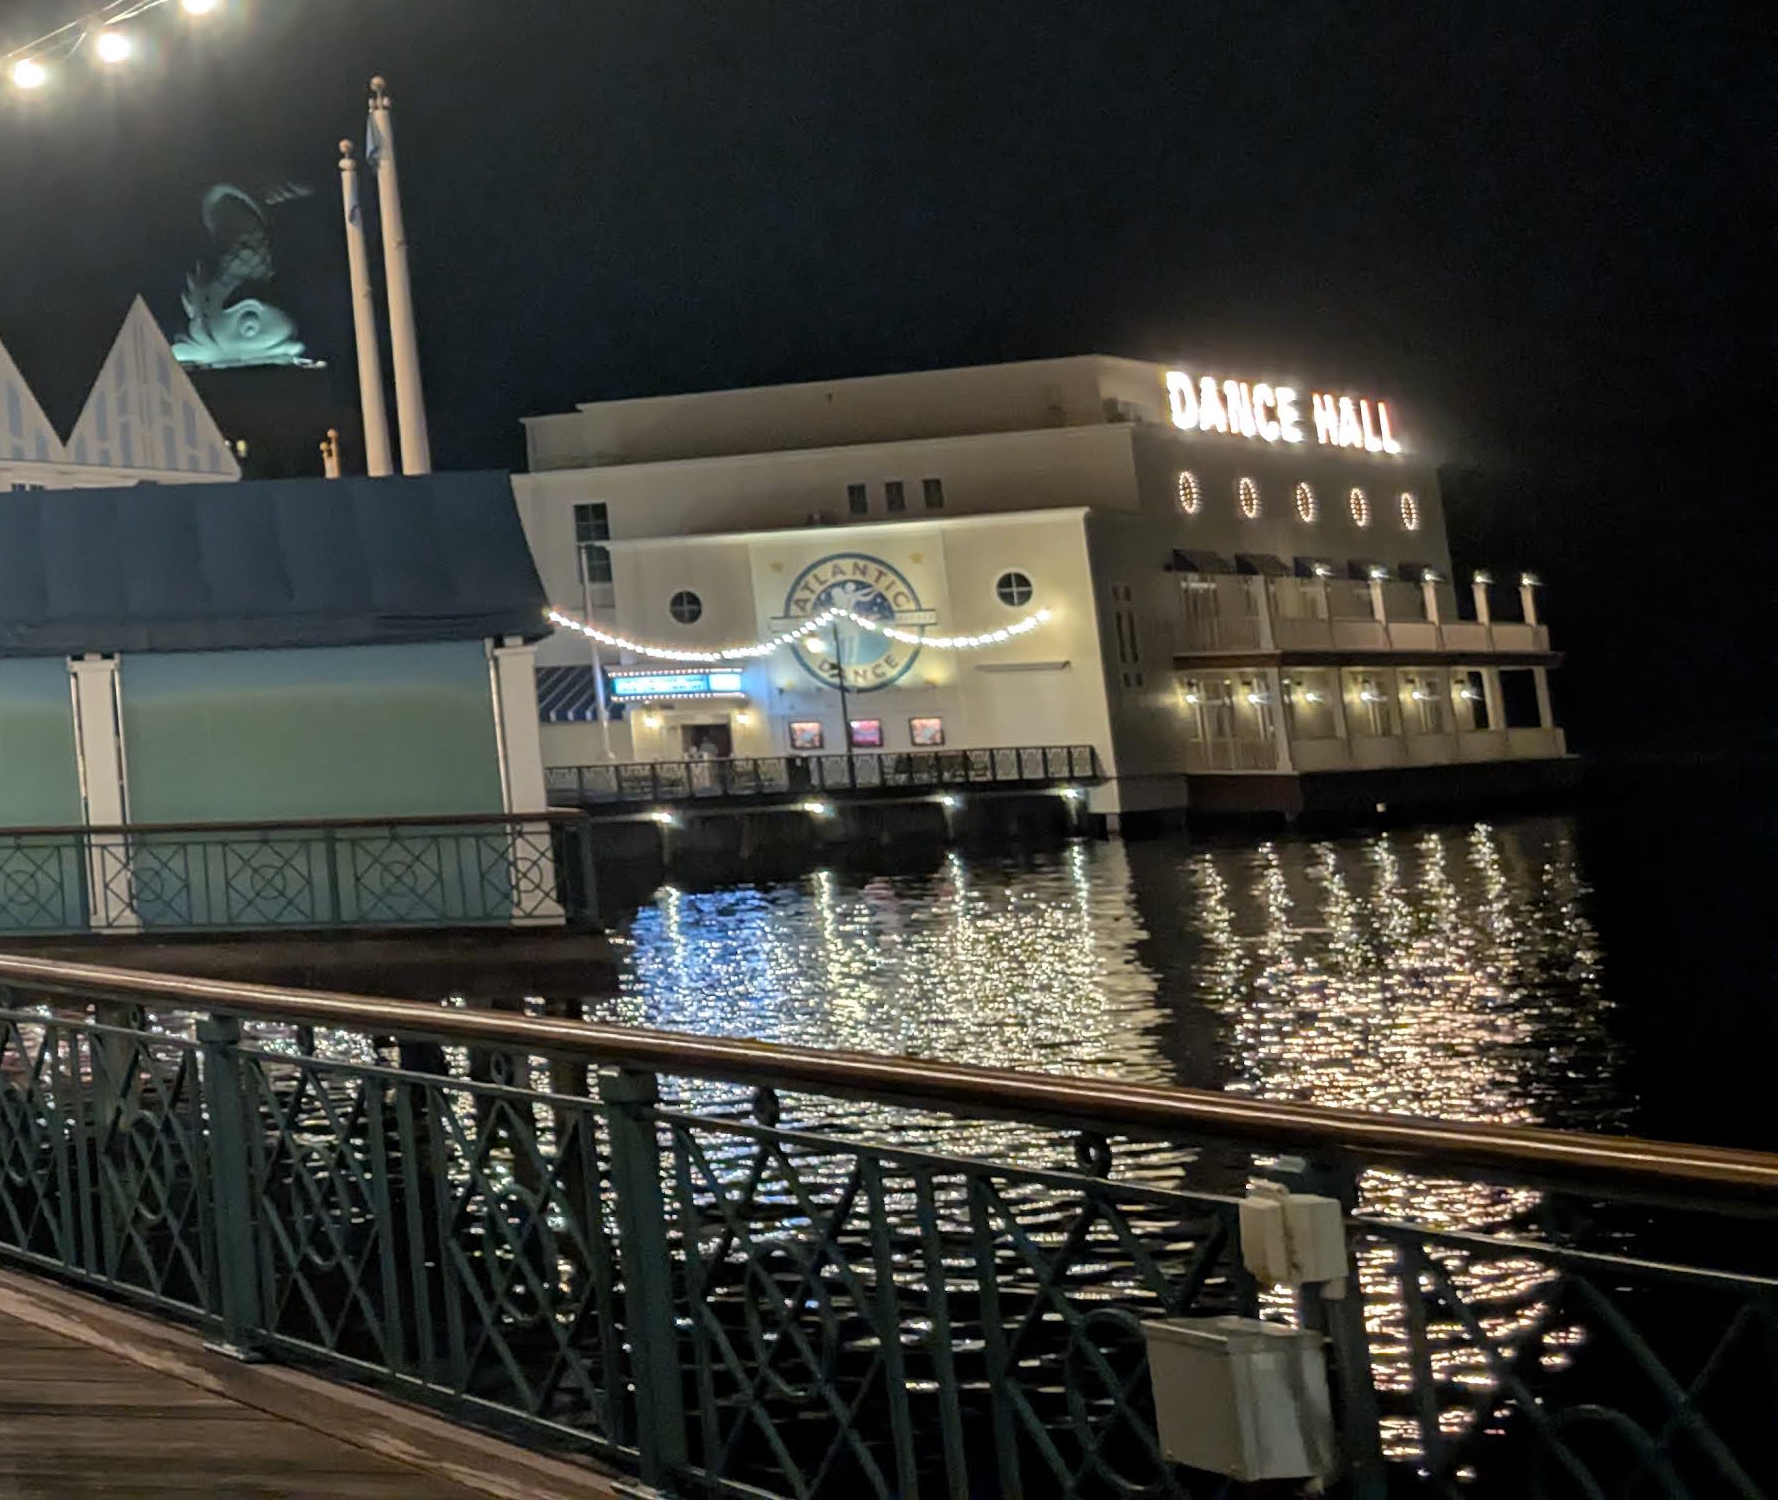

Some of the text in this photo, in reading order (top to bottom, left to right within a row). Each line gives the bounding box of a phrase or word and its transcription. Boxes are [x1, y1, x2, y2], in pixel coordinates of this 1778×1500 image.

[1166, 371, 1401, 454] DANCE HALL
[794, 561, 911, 613] ATLANTIC
[818, 654, 900, 683] DNCE
